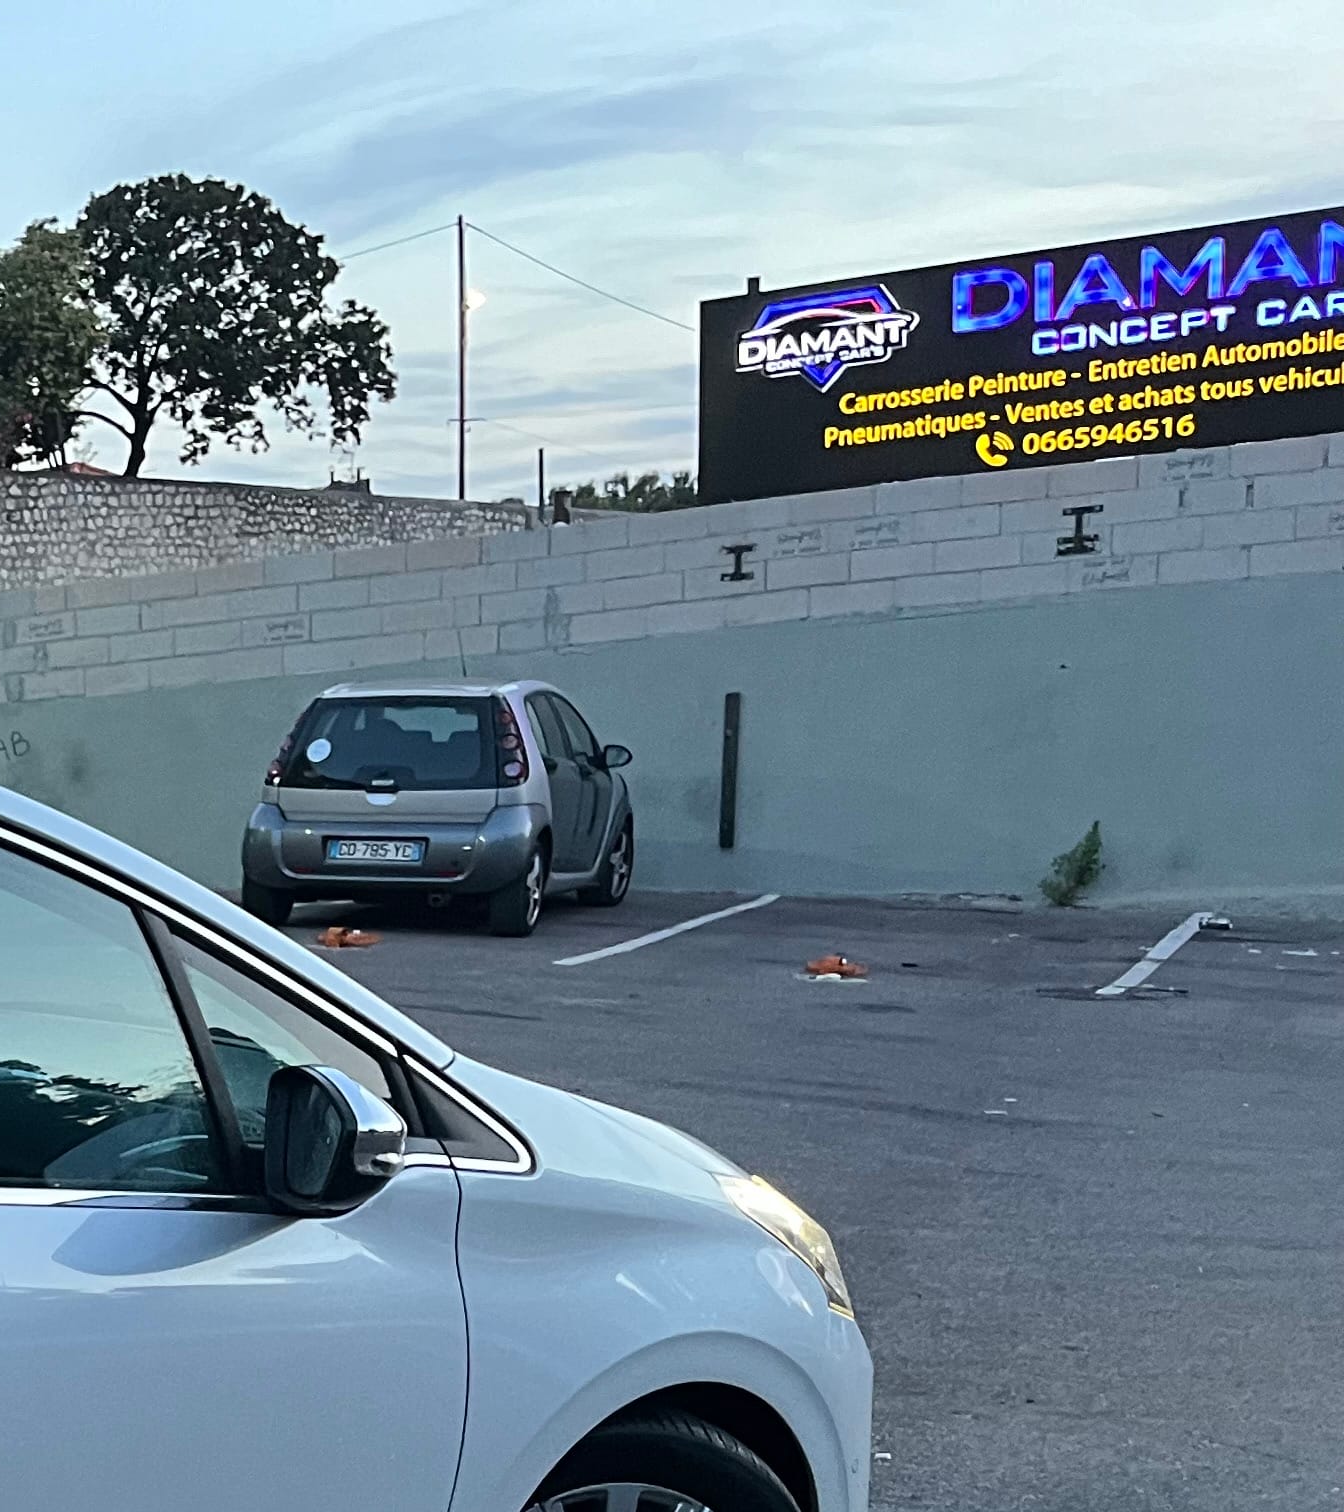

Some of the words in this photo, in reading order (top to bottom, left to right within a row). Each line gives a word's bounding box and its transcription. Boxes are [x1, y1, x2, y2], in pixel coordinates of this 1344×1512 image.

[738, 320, 907, 365] DIAMANT
[1031, 305, 1236, 356] CONCEPT
[766, 353, 834, 372] CONCEPT
[838, 379, 964, 415] Carrosserie
[968, 369, 1066, 397] Peinture
[1089, 352, 1197, 382] Entretien
[1202, 329, 1344, 368] Automobile
[824, 411, 986, 448] Pneumatiques
[1005, 399, 1085, 424] Ventes
[1089, 393, 1114, 415] et
[1118, 385, 1196, 410] achats
[1200, 377, 1253, 400] tous
[1022, 415, 1195, 455] 0665946516
